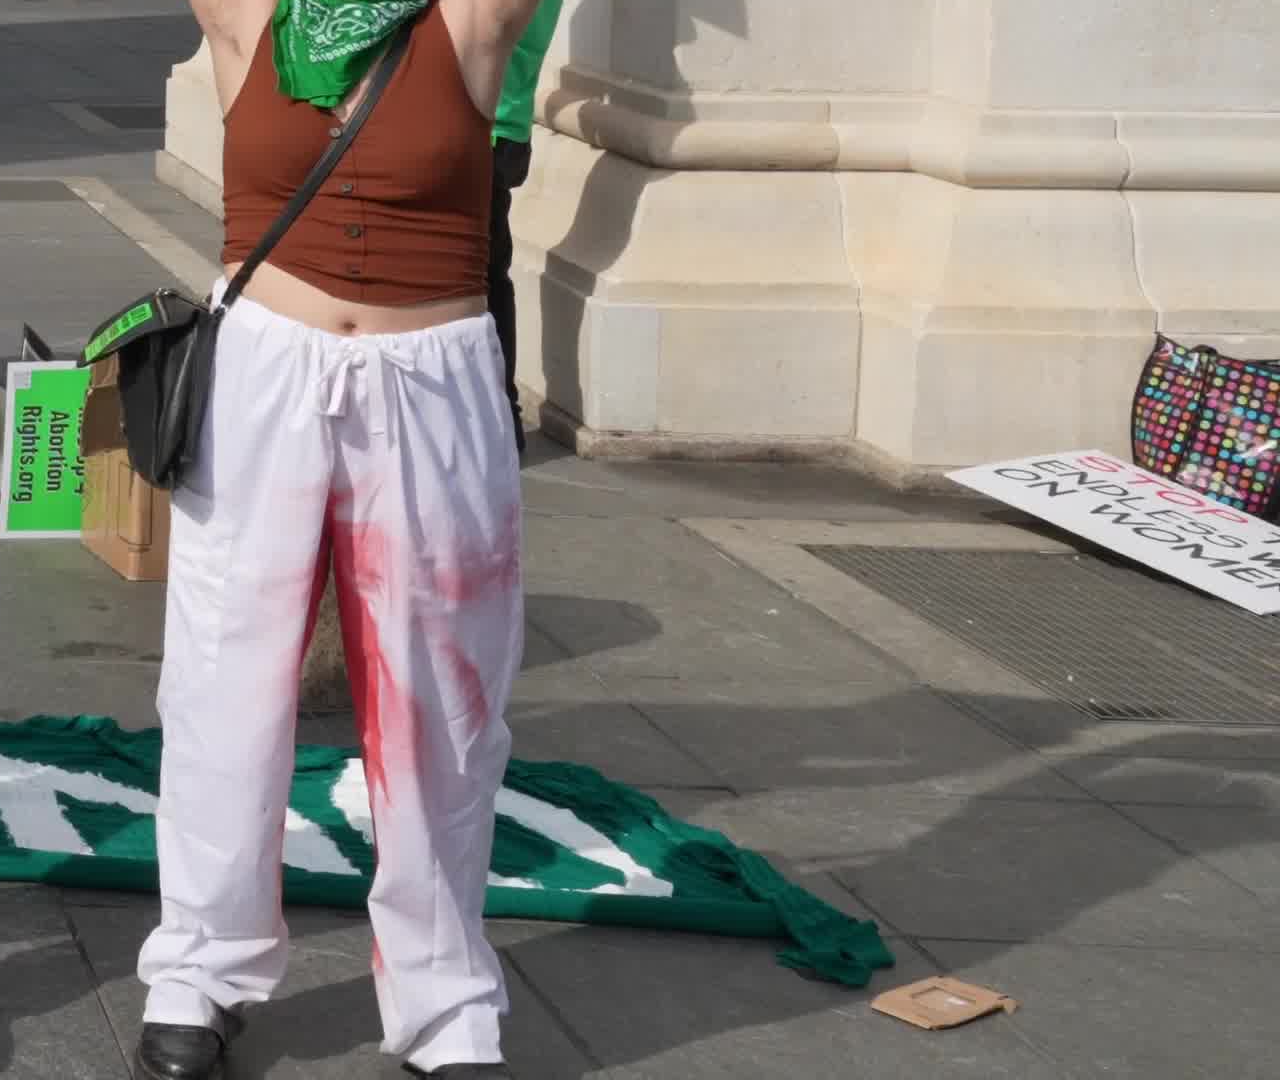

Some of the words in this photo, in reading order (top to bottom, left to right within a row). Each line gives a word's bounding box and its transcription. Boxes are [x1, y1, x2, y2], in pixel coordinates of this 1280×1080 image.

[13, 406, 42, 502] Rights.org
[47, 410, 70, 491] Abortion
[993, 467, 1081, 498] ON
[1074, 455, 1249, 524] STOP
[1032, 459, 1249, 549] ENDLESS
